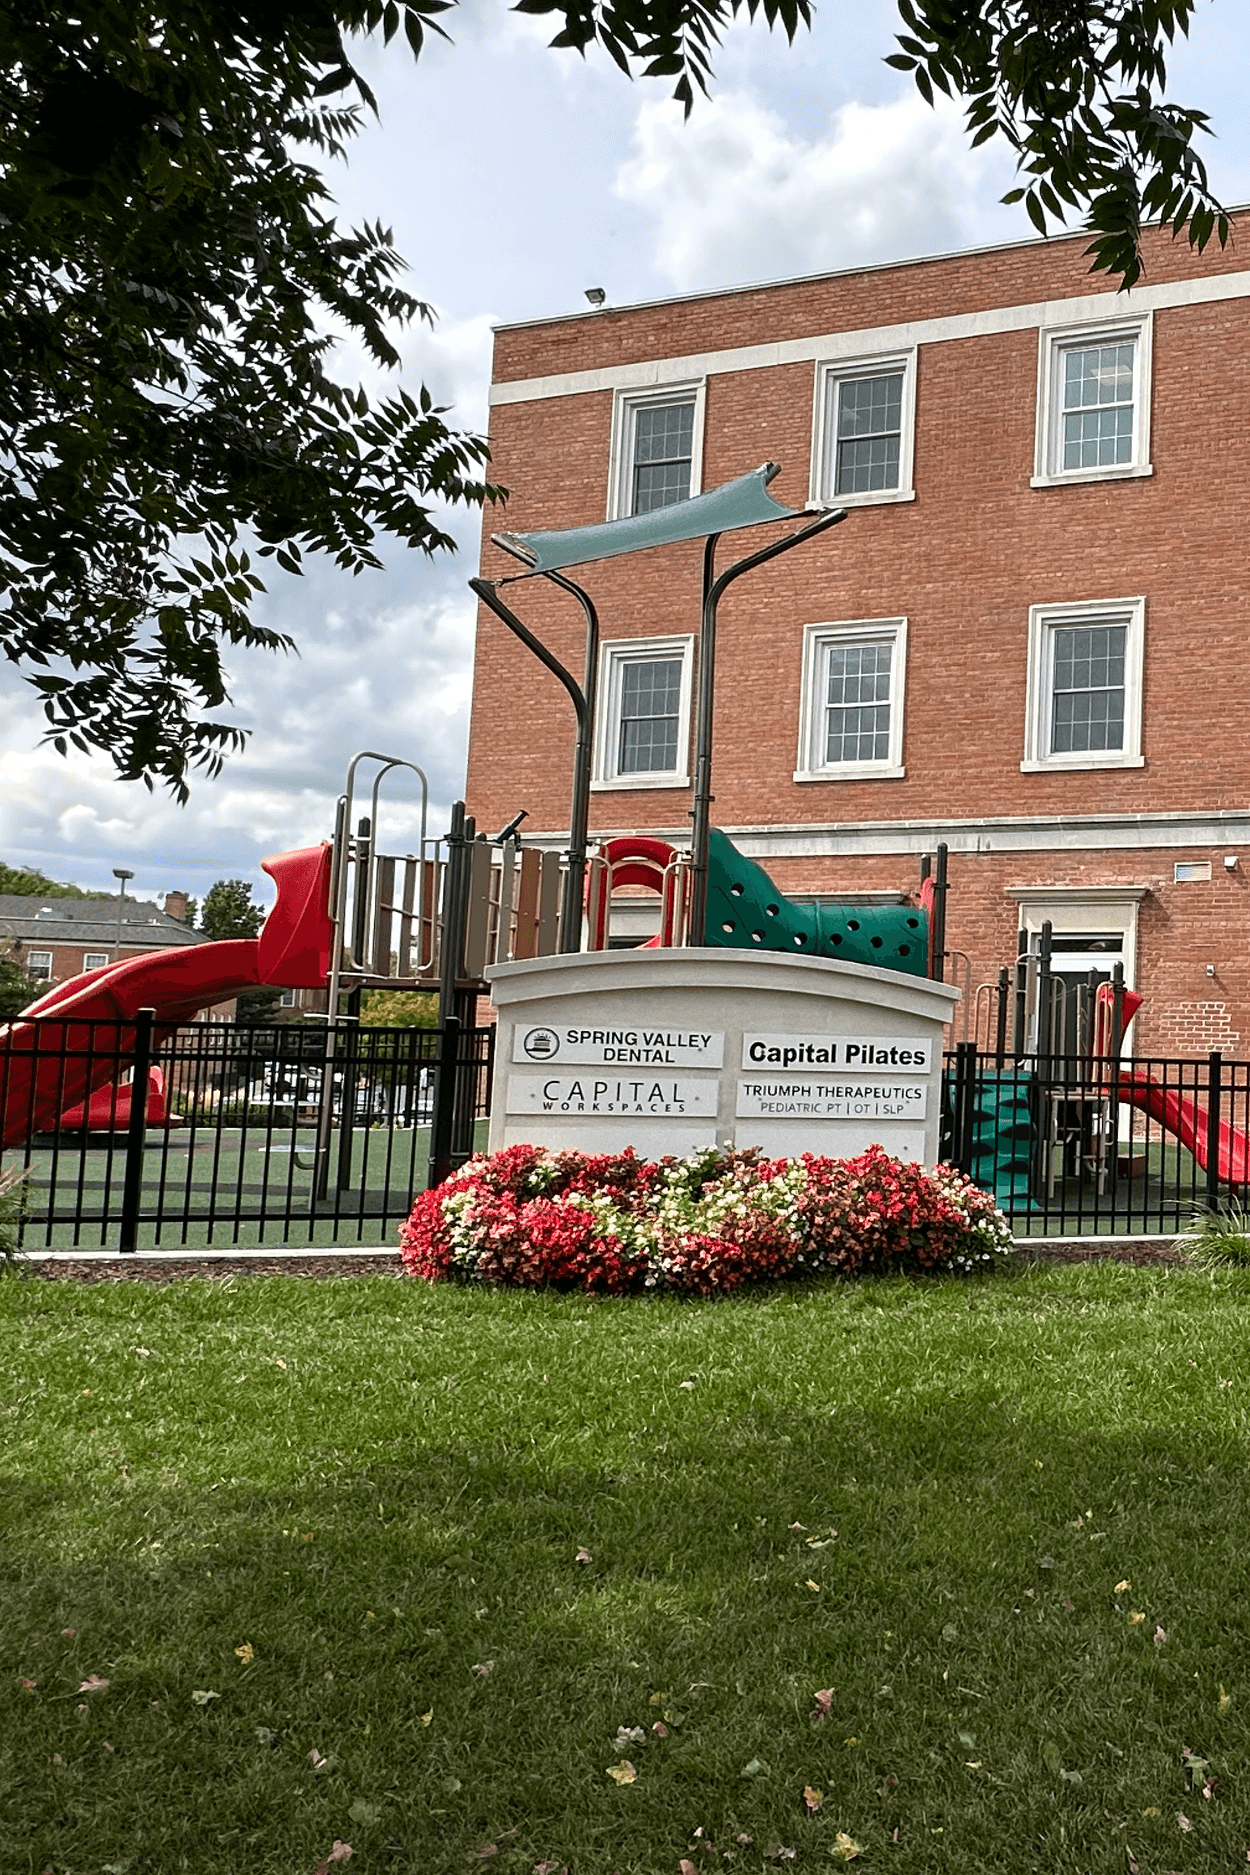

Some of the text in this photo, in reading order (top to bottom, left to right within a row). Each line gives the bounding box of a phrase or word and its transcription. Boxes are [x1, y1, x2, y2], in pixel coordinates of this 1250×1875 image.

[566, 1030, 712, 1048] SPRING VALLEY
[603, 1048, 675, 1063] DENTAL
[749, 1041, 926, 1067] Capital Pilates
[543, 1080, 685, 1103] CAPITAL
[743, 1084, 922, 1099] TRIUMPH THERAPEUTICS
[543, 1101, 685, 1112] WORKSPACES
[760, 1102, 904, 1115] PEDIATRIC PT OT SLP
